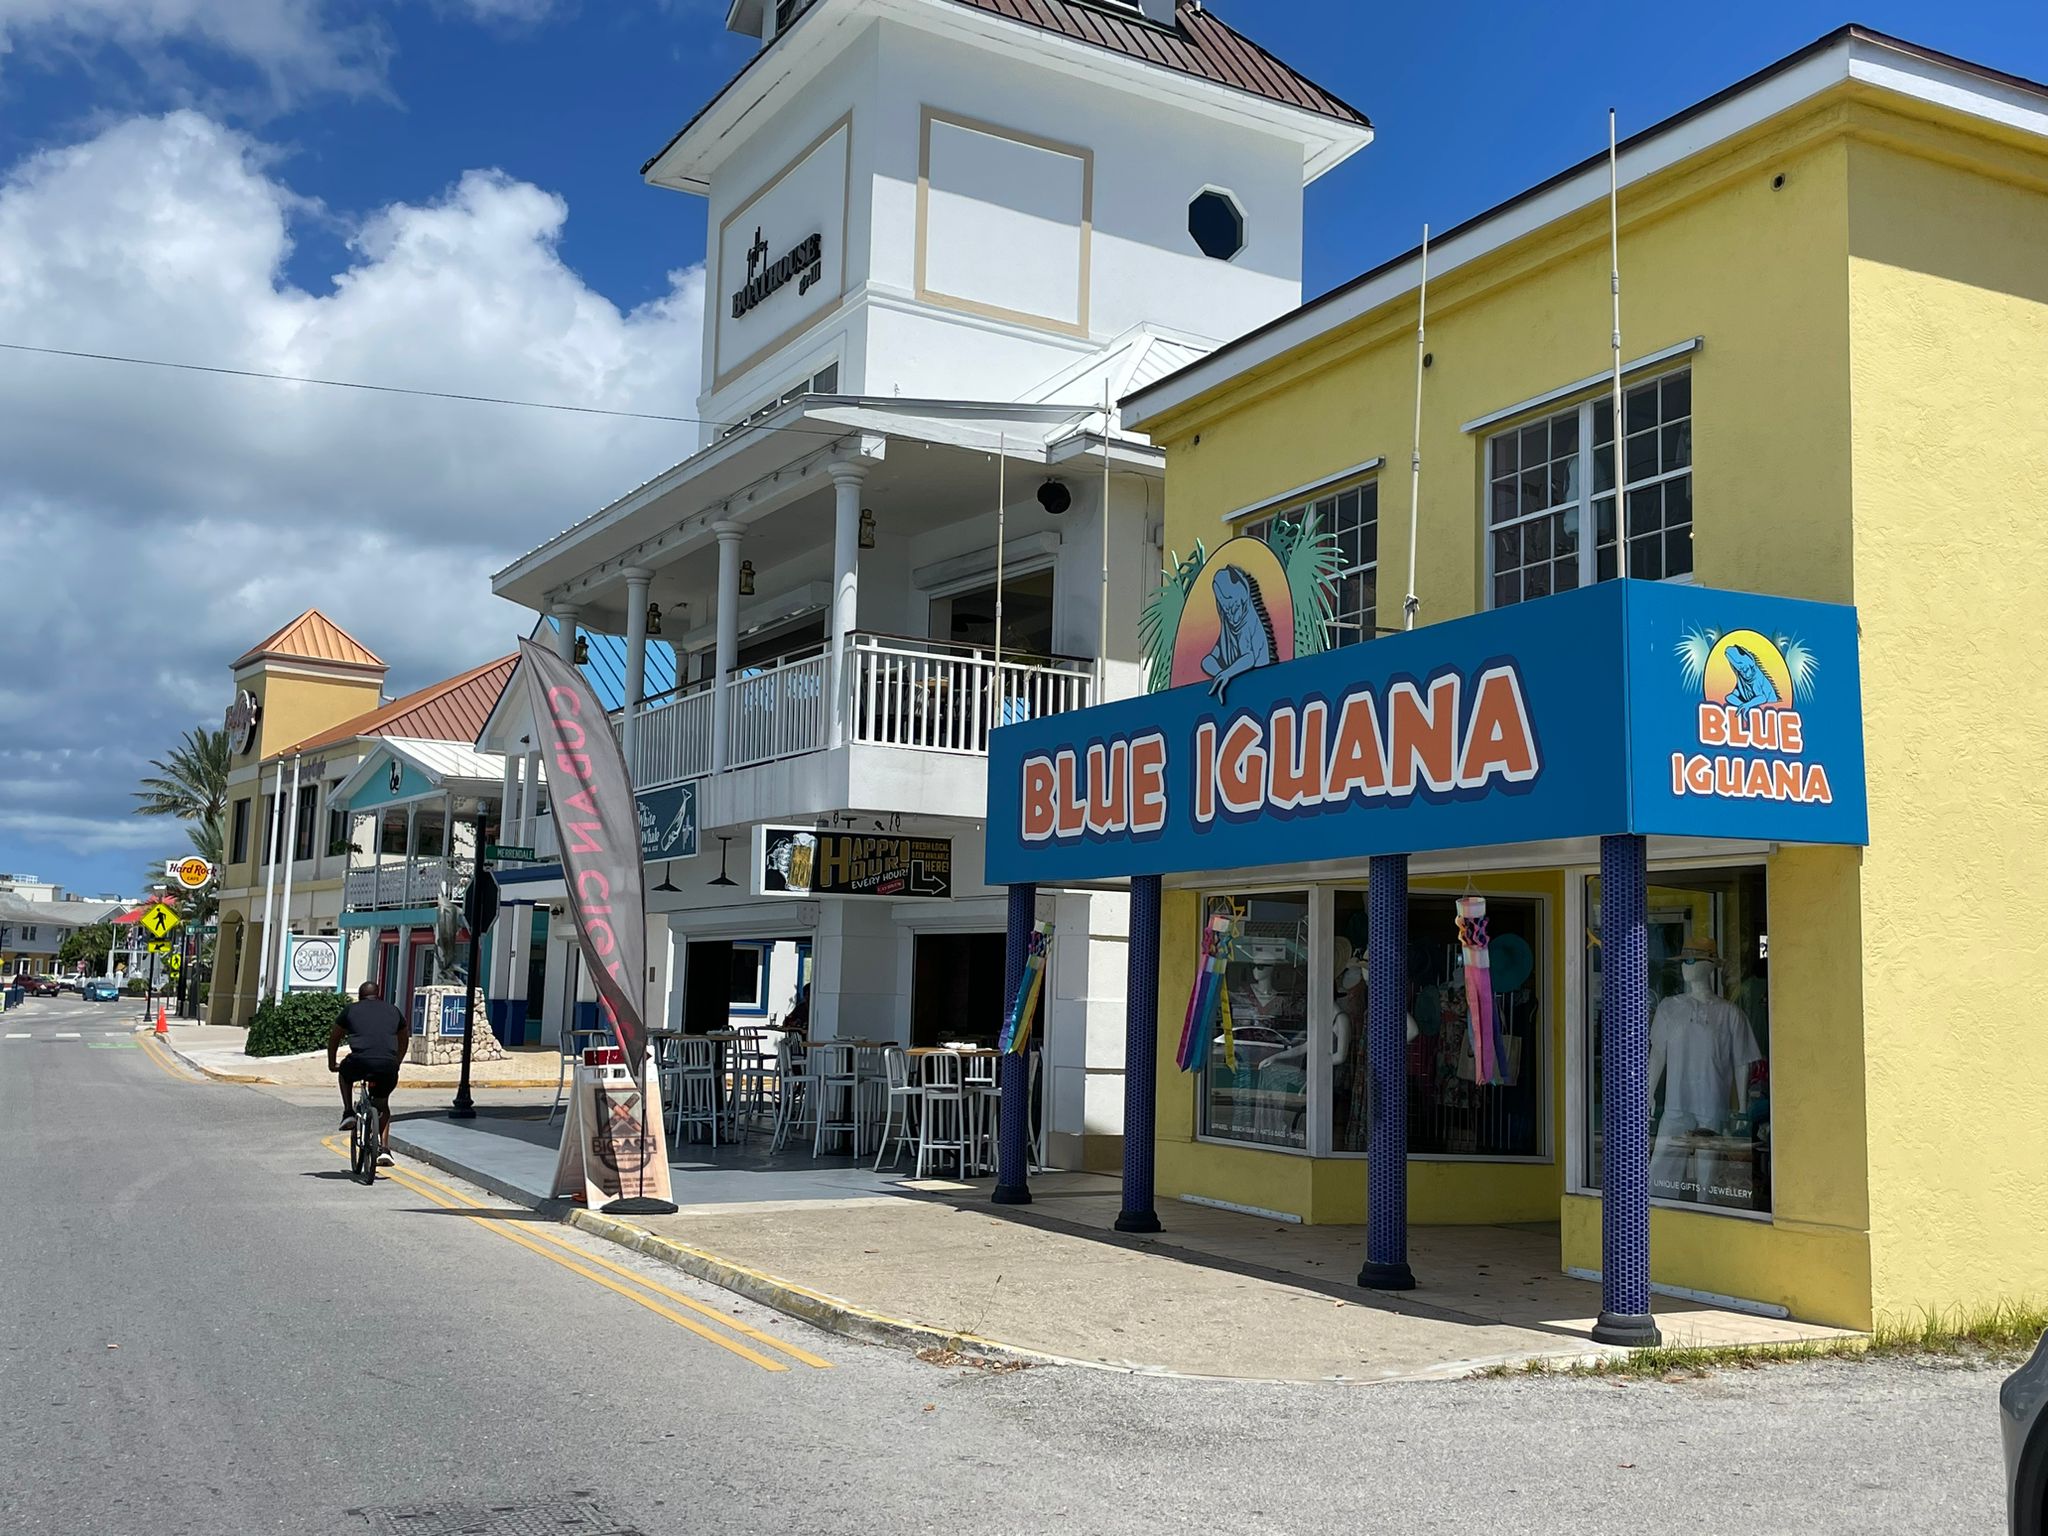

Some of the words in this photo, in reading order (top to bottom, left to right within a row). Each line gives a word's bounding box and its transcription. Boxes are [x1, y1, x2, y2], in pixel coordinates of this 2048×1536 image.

[732, 233, 822, 319] BOATHOUSE
[1699, 703, 1803, 753] BLUE
[1021, 732, 1167, 841] BLUE
[1195, 665, 1539, 824] IGUANA
[1671, 752, 1832, 803] IGUANA
[641, 826, 660, 845] Whale
[169, 862, 194, 874] Hard
[194, 864, 218, 877] Rock
[924, 860, 949, 873] HERE!
[851, 875, 880, 890] EVERY
[1653, 1179, 1680, 1190] UNIQUE
[1680, 1182, 1701, 1192] GIFTS
[1708, 1185, 1752, 1199] JEWELLERY
